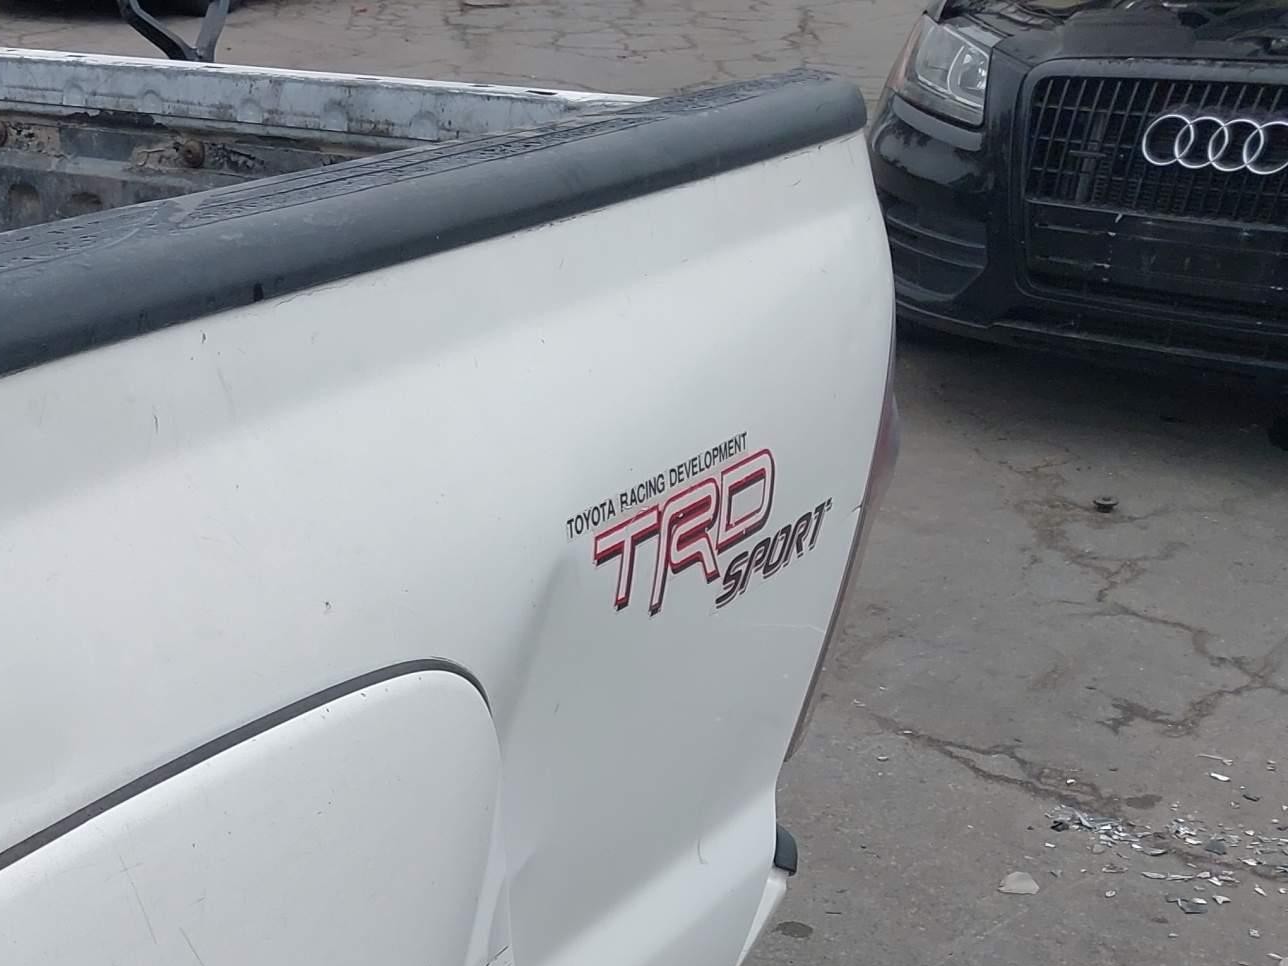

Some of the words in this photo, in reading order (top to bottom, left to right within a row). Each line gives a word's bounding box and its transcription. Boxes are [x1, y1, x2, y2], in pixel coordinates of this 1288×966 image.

[567, 499, 616, 539] TOYOTA
[618, 473, 666, 509] RACING
[669, 431, 748, 488] DEVELOPMENT
[593, 448, 775, 617] TRD
[715, 499, 829, 609] SPORT
